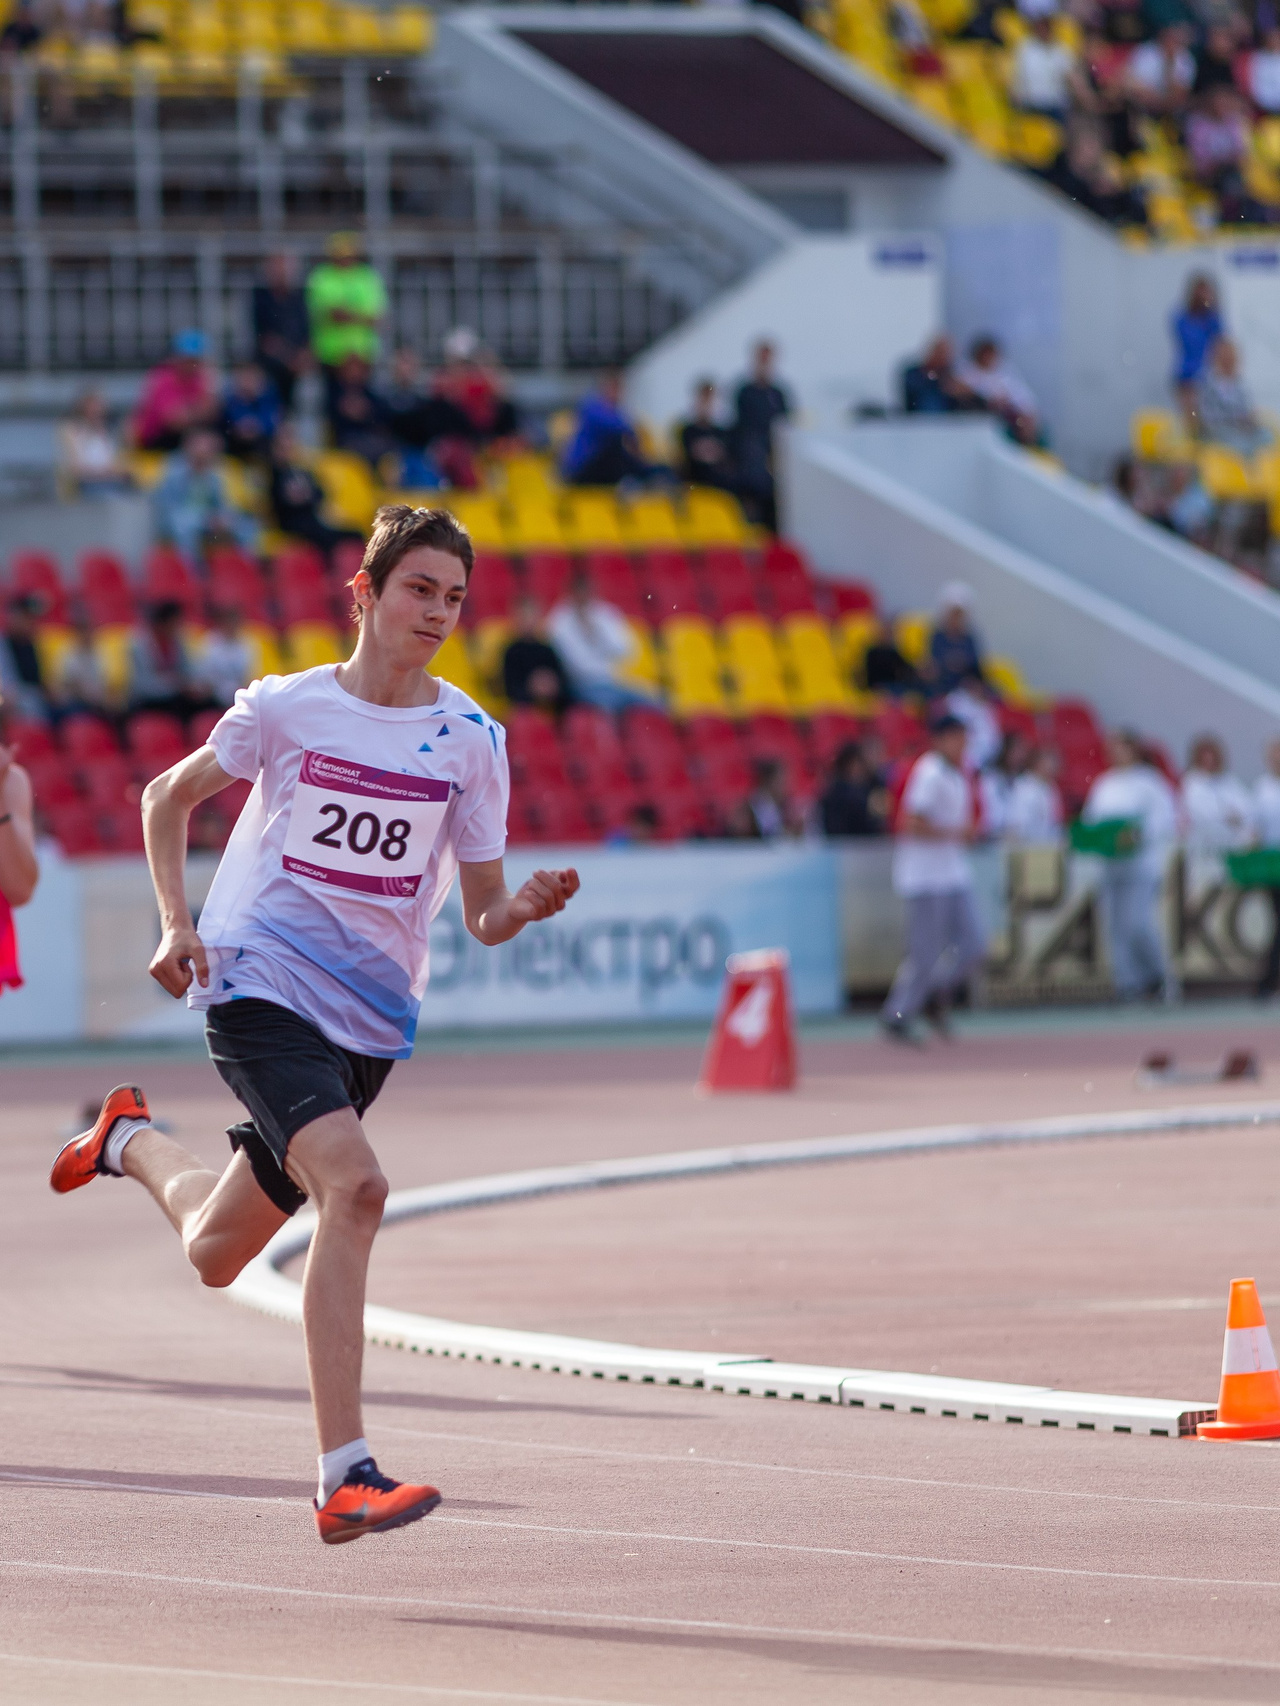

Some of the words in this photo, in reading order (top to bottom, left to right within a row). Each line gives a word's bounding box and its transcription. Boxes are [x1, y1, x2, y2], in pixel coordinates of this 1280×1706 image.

[309, 767, 359, 785] ПРИВОЛЖСКОГО
[360, 781, 408, 796] ФЕДЕРАЛЬНОГО
[408, 791, 430, 800] ОКРУГА
[312, 760, 361, 778] ЧЕМПИОНАТ
[312, 803, 412, 862] 208
[288, 861, 328, 879] ЧЕБОКСАРЫ
[725, 981, 771, 1047] 4
